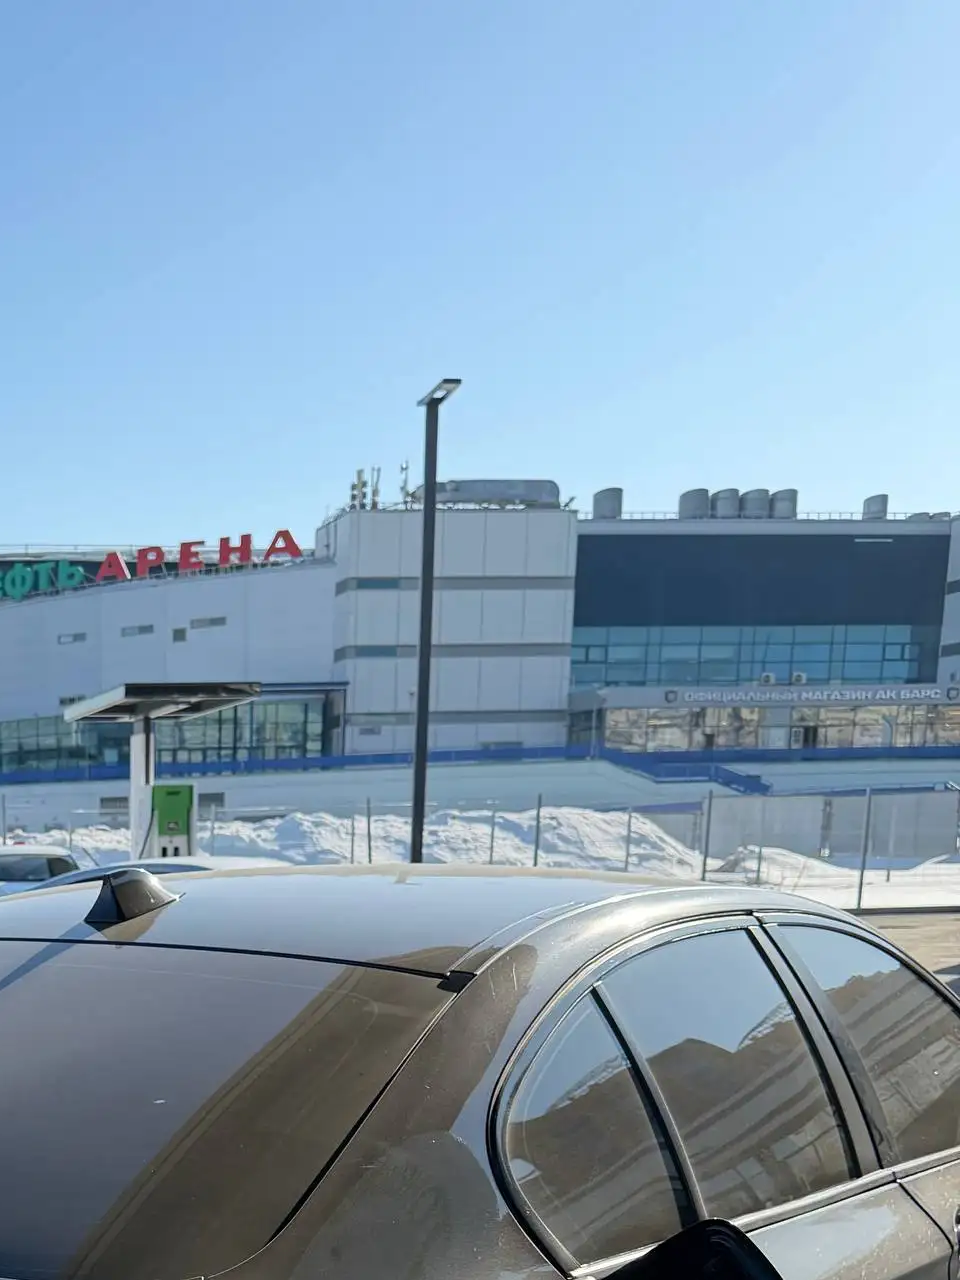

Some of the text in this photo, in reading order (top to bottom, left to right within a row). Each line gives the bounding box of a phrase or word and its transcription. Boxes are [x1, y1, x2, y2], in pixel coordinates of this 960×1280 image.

[95, 529, 303, 583] АРЕНА
[801, 690, 872, 701] МАГАЗИН
[876, 690, 897, 700] АК
[900, 689, 941, 699] БАРС
